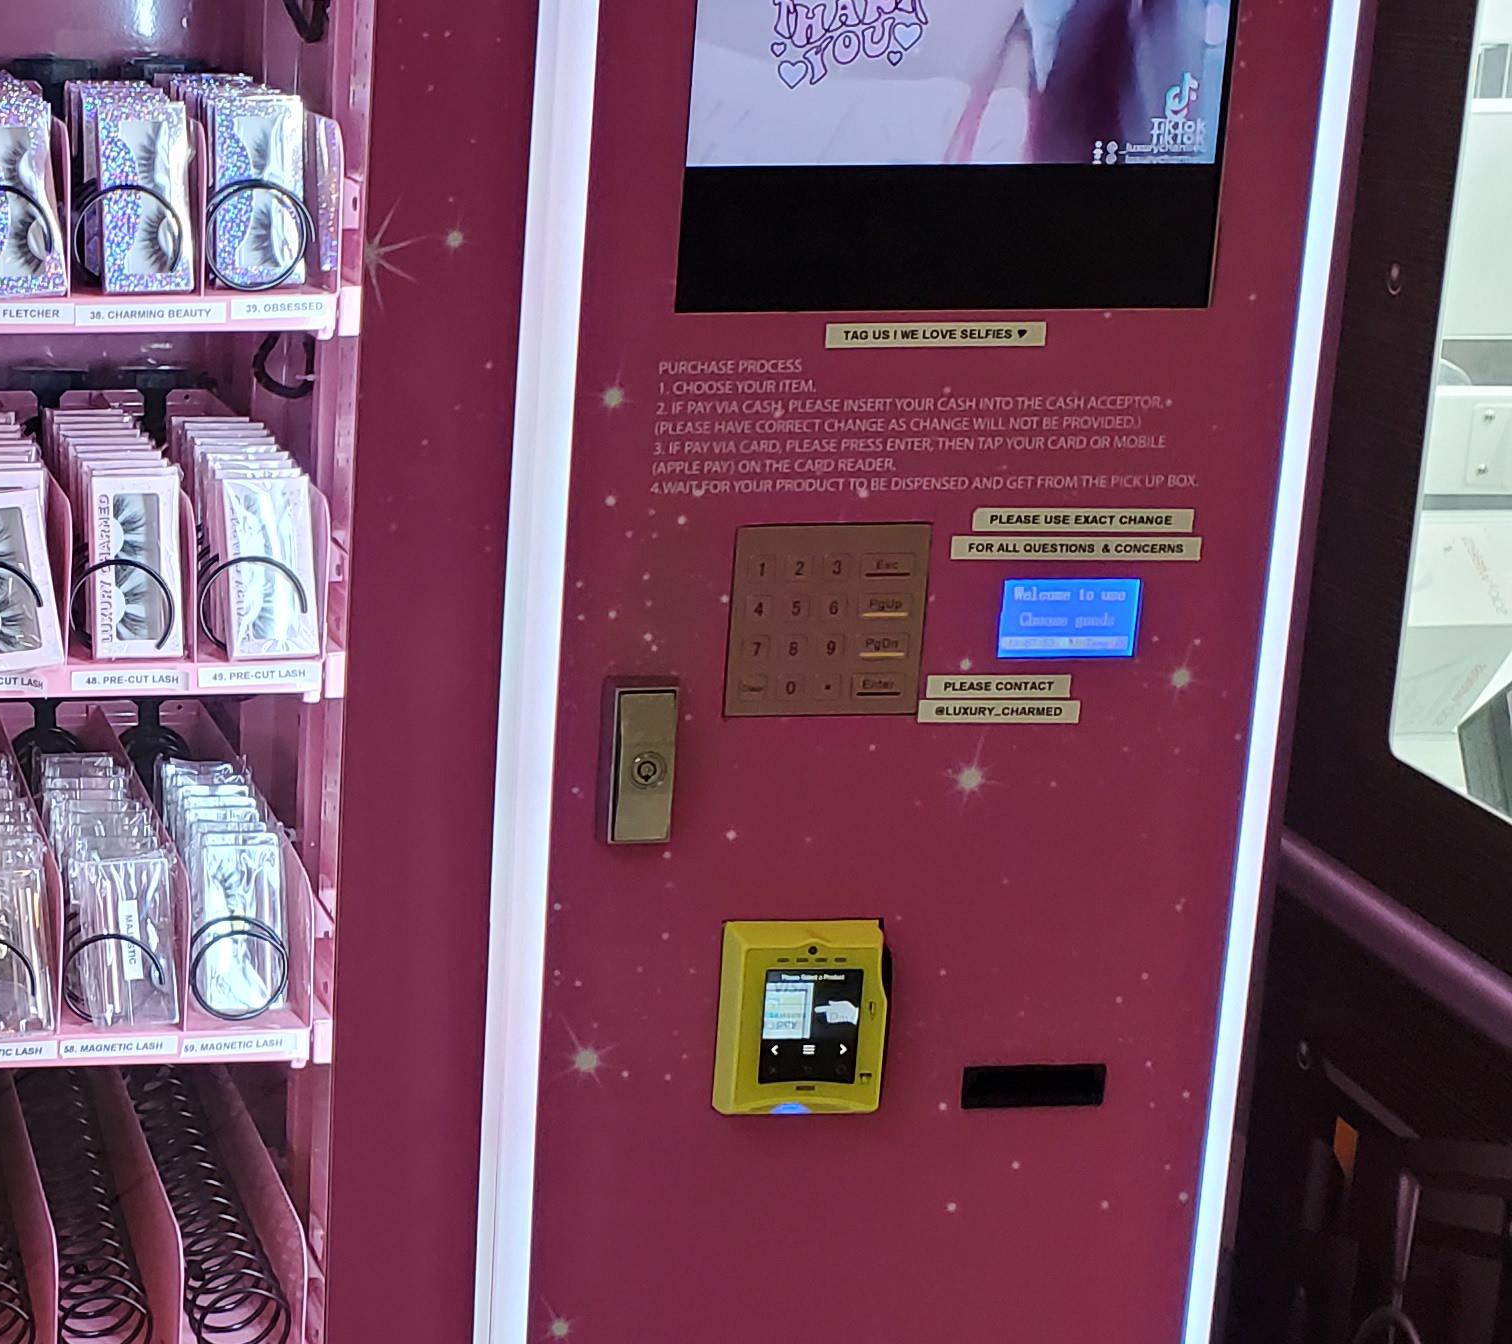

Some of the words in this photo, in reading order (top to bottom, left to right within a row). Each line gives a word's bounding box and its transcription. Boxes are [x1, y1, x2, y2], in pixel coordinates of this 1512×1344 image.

[802, 16, 895, 86] YOU
[3, 308, 59, 319] FLETCHER
[108, 309, 164, 320] CHARMING
[168, 308, 211, 319] BEAUTY
[843, 329, 869, 341] TAG
[872, 329, 890, 340] US
[900, 329, 919, 340] WE
[922, 329, 957, 340] LOVE
[960, 328, 1013, 340] SELFIES
[658, 360, 735, 375] PURCHASE
[738, 358, 802, 373] PROCESS
[672, 380, 735, 395] CHOOSE
[737, 379, 776, 394] YOUR
[778, 379, 817, 394] ITEM.
[651, 460, 701, 476] (APPLE
[703, 460, 736, 475] PAY)
[738, 460, 762, 474] ON
[764, 459, 792, 473] THE
[794, 458, 836, 473] CARD
[838, 457, 896, 472] READER.
[989, 514, 1041, 526] PLEASE
[1043, 515, 1070, 526] USE
[1073, 514, 1116, 526] EXACT
[1118, 515, 1173, 526] CHANGE
[968, 543, 993, 554] FOR
[996, 543, 1020, 554] ALL
[1023, 543, 1095, 555] QUESTIONS
[1101, 543, 1111, 554] &
[1114, 543, 1184, 554] CONCERNS
[758, 561, 766, 577] 1
[794, 560, 805, 577] 2
[831, 559, 842, 576] 3
[753, 601, 764, 617] 4
[791, 600, 801, 616] 5
[828, 600, 838, 616] 6
[753, 642, 762, 657] 7
[788, 641, 798, 657] 8
[826, 640, 836, 656] 9
[785, 680, 796, 695] 0
[943, 681, 992, 692] PLEASE
[994, 680, 1054, 692] CONTACT
[934, 706, 1063, 718] @LUXURY_CHARMED
